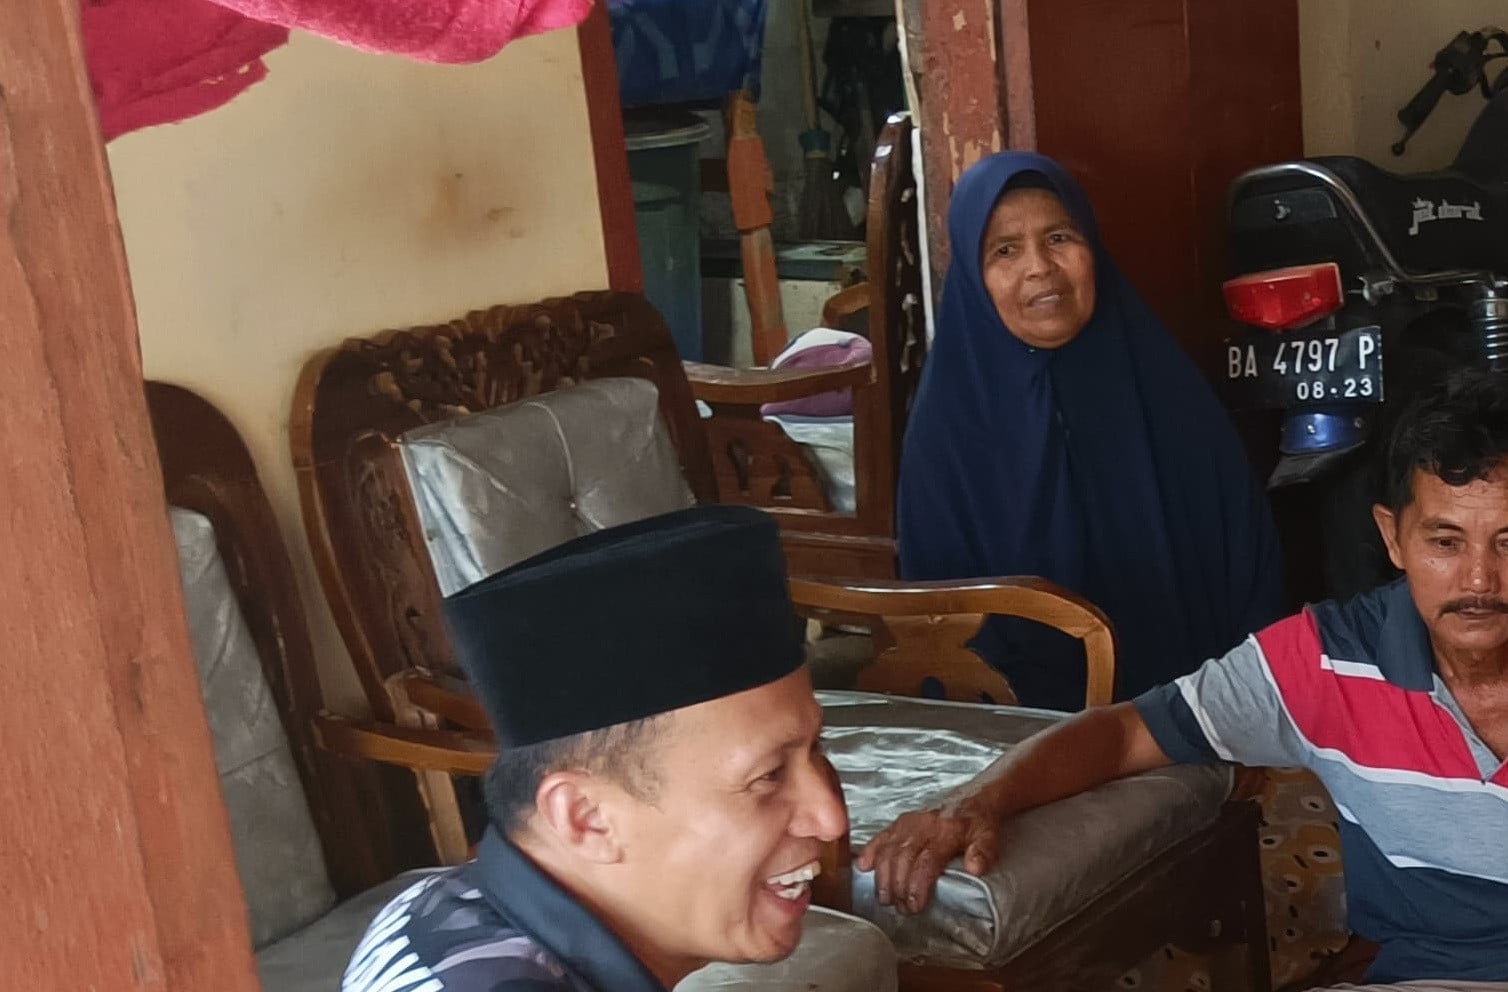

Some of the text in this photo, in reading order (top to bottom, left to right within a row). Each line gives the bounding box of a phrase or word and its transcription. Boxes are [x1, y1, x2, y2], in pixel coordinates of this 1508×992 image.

[1228, 335, 1375, 378] BA 4797 P
